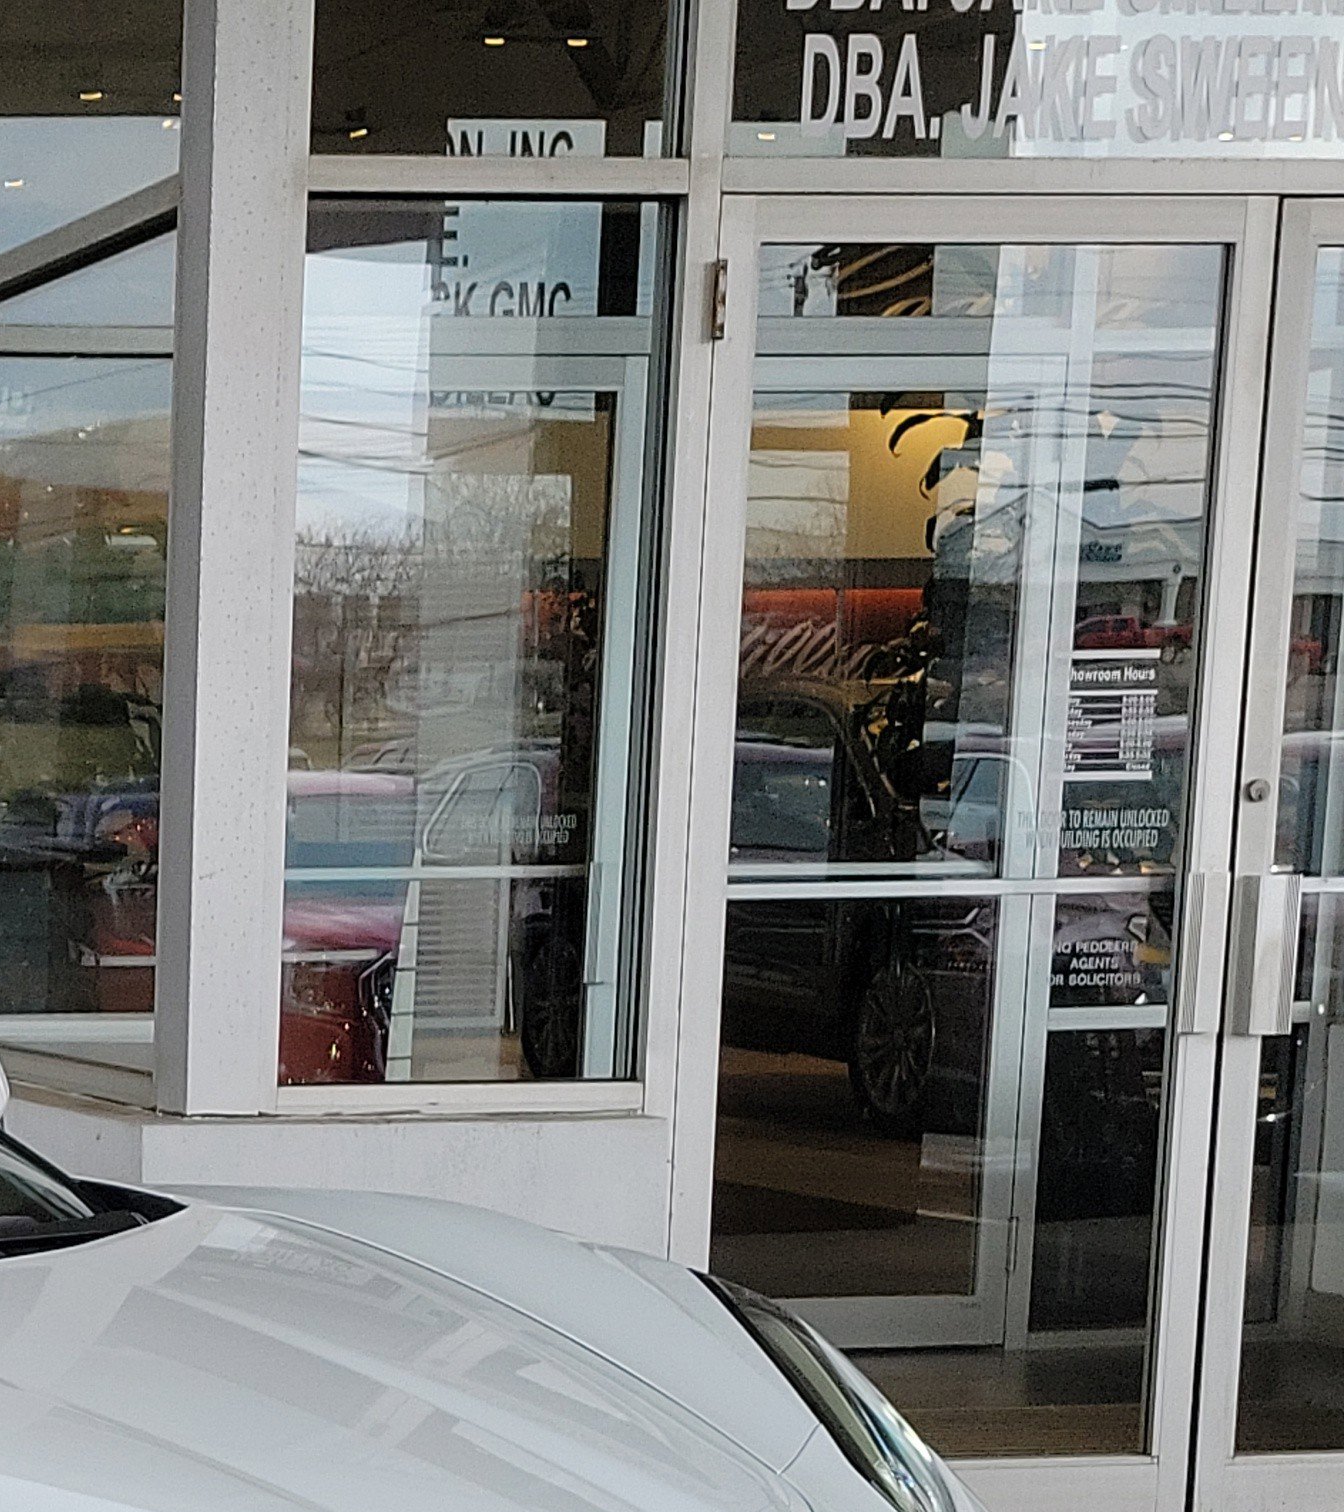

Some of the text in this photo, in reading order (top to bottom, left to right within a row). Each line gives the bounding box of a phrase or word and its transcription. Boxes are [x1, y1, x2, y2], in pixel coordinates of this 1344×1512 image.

[800, 33, 941, 140] DBA.
[961, 33, 1122, 141] JAKE
[489, 280, 572, 317] GMC
[1069, 666, 1156, 683] howroom Hours
[1069, 809, 1082, 828] TO
[1083, 808, 1118, 828] REMAIN
[1120, 808, 1170, 828] UNLOCKED
[1101, 830, 1111, 848] IS
[1112, 829, 1159, 848] OCCUPIED
[1070, 956, 1119, 970] AGENTS
[1068, 971, 1141, 987] SOLICITORS
